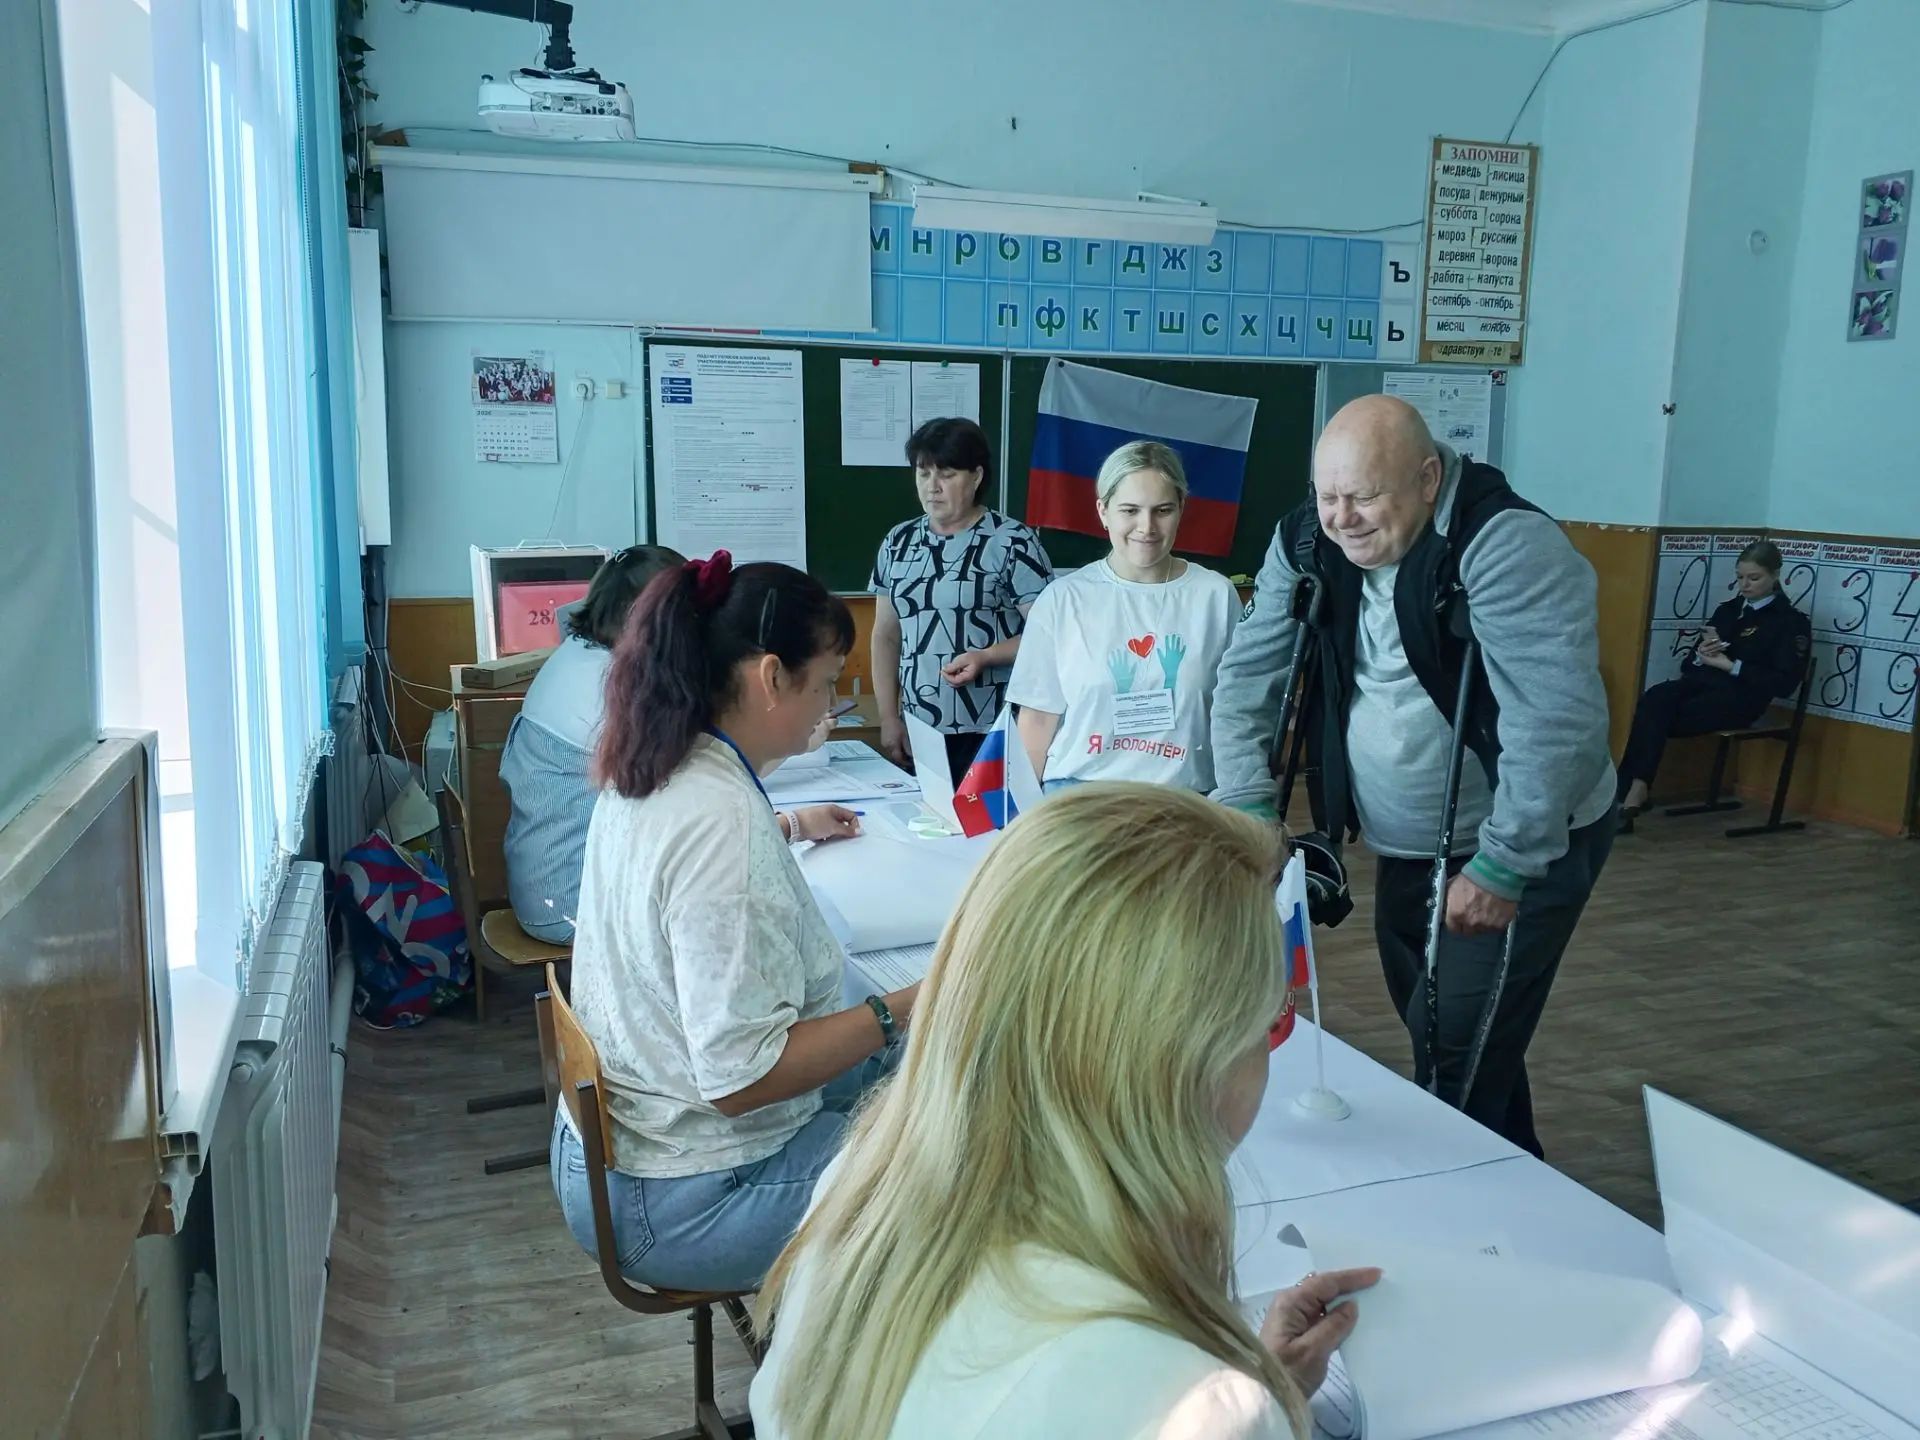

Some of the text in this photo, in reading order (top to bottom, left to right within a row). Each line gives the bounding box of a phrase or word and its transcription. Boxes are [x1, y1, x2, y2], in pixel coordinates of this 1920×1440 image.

[1451, 147, 1519, 164] ЗАПОМНИ
[1442, 164, 1525, 183] медведь лисица
[1440, 187, 1524, 205] посуда дежурный
[1440, 205, 1478, 221] суббота
[1437, 230, 1466, 244] мороз
[1438, 250, 1518, 268] деревня ворона
[1433, 270, 1514, 288] работа капуста
[1432, 293, 1514, 311] сентябрь октябрь
[1436, 319, 1511, 334] месяц ноябрь
[1664, 535, 1685, 543] ПИШИ
[1792, 541, 1819, 550] ЦИФРЫ
[1822, 543, 1875, 555] ПИШИ ЦИФРЫ
[1825, 552, 1870, 563] ПРАВИЛЬНО
[1834, 569, 1873, 632] 3
[1821, 644, 1920, 718] 8 9
[1087, 734, 1103, 754] Я
[1112, 737, 1187, 762] ВОЛОНТЁР!
